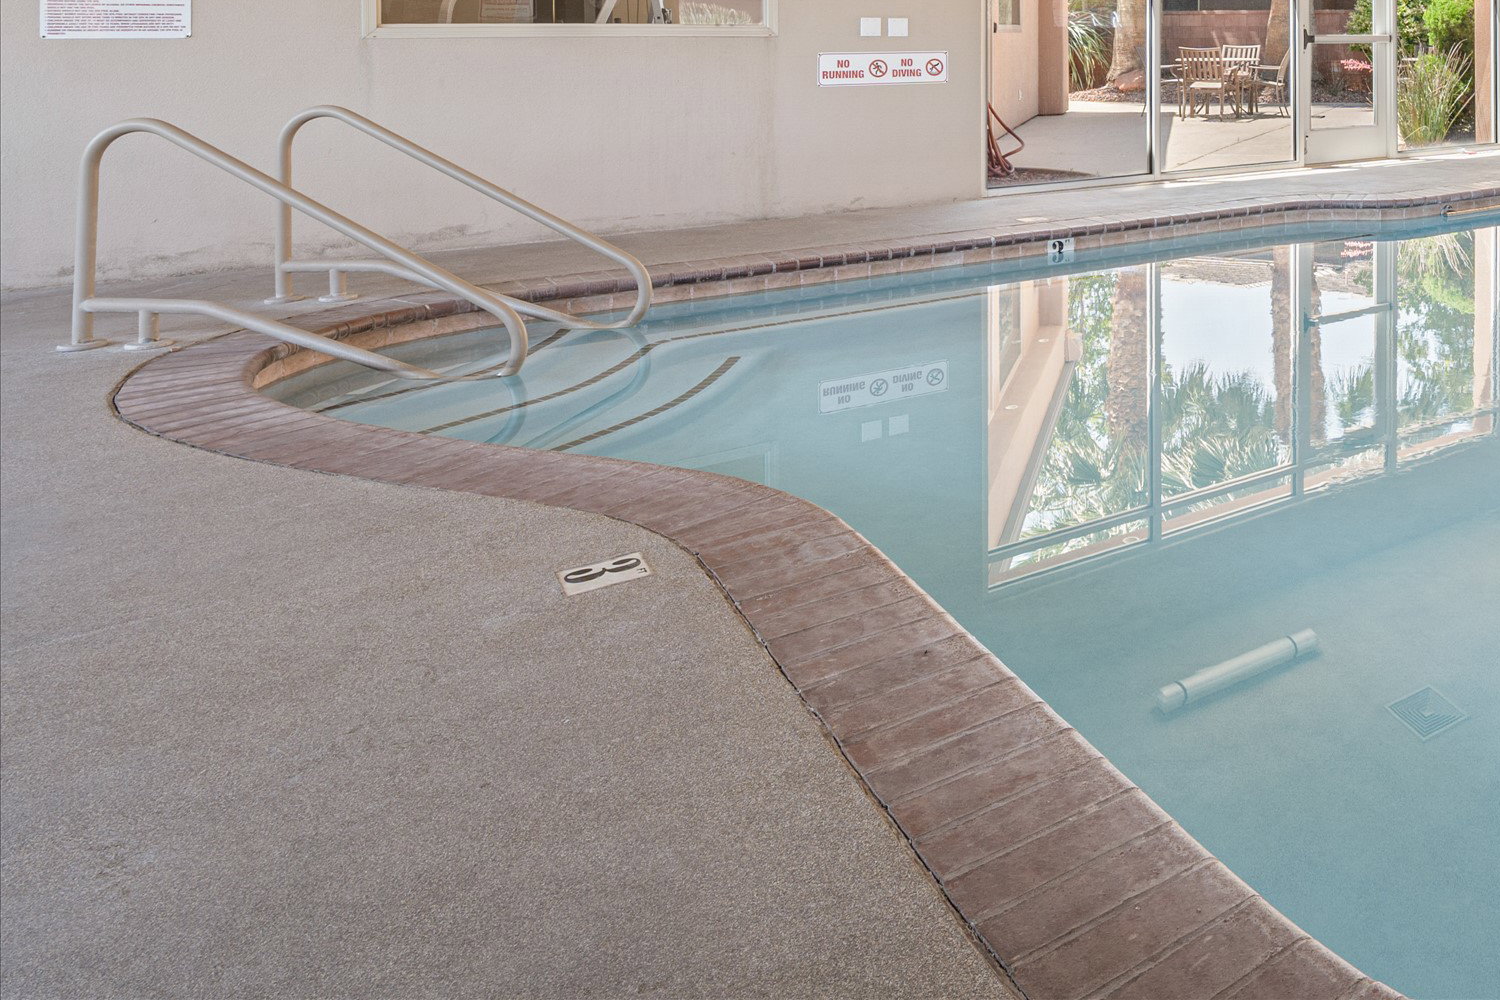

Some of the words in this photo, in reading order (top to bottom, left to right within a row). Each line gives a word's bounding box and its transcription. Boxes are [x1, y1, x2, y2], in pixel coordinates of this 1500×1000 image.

[836, 59, 850, 68] NO
[900, 58, 913, 67] NO
[822, 69, 865, 79] RUNNING
[892, 68, 922, 78] DIVING
[564, 558, 641, 583] 3
